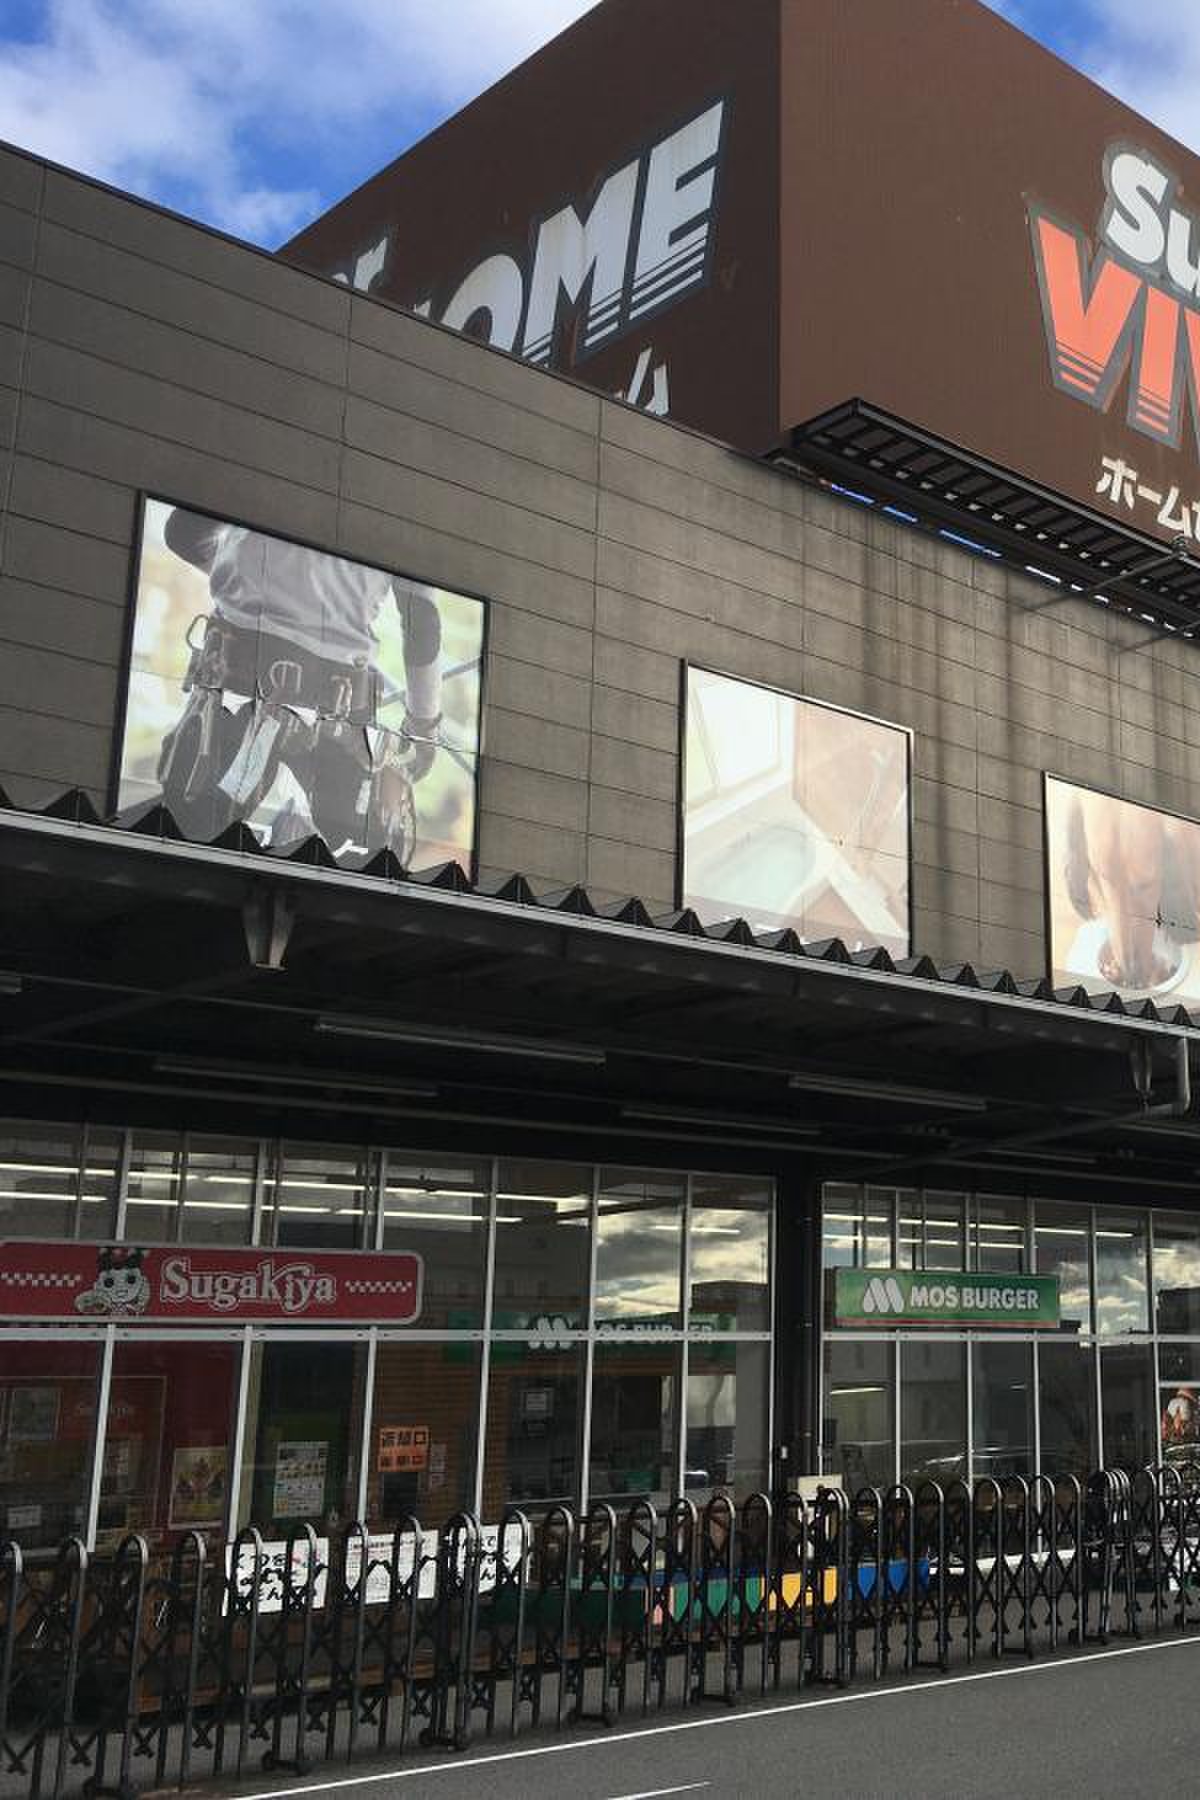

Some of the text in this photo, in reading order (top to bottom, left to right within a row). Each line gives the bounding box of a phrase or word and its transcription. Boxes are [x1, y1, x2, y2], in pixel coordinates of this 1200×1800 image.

[414, 101, 723, 366] OME
[911, 1285, 1040, 1310] MOS BURGER
